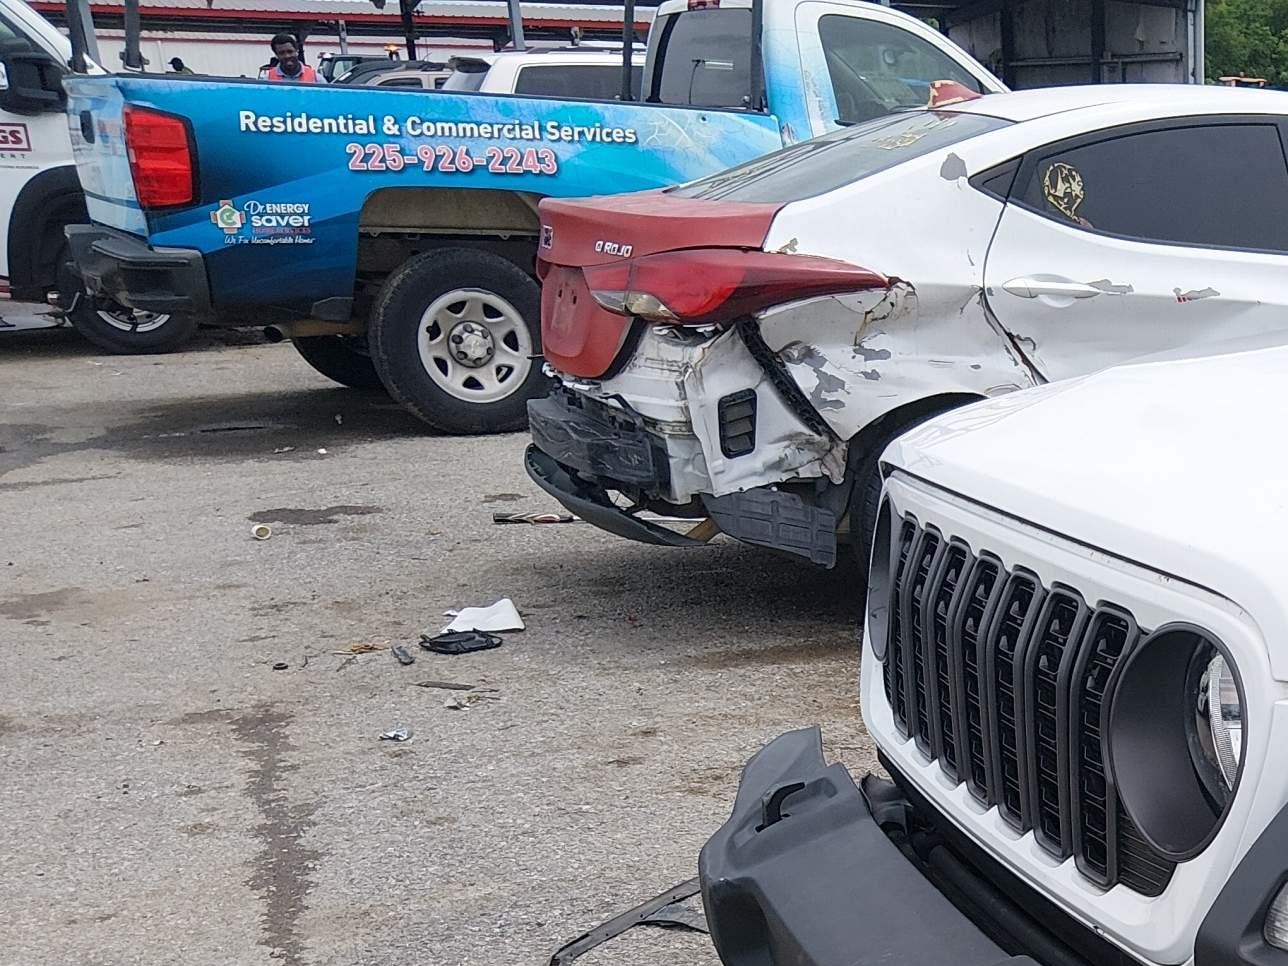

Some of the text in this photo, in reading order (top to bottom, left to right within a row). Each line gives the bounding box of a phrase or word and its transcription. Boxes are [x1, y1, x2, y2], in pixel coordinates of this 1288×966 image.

[239, 110, 637, 143] Residential & Commercial Services
[345, 143, 558, 175] 225-926-2243
[266, 203, 309, 213] ENERGY
[251, 215, 312, 227] saver
